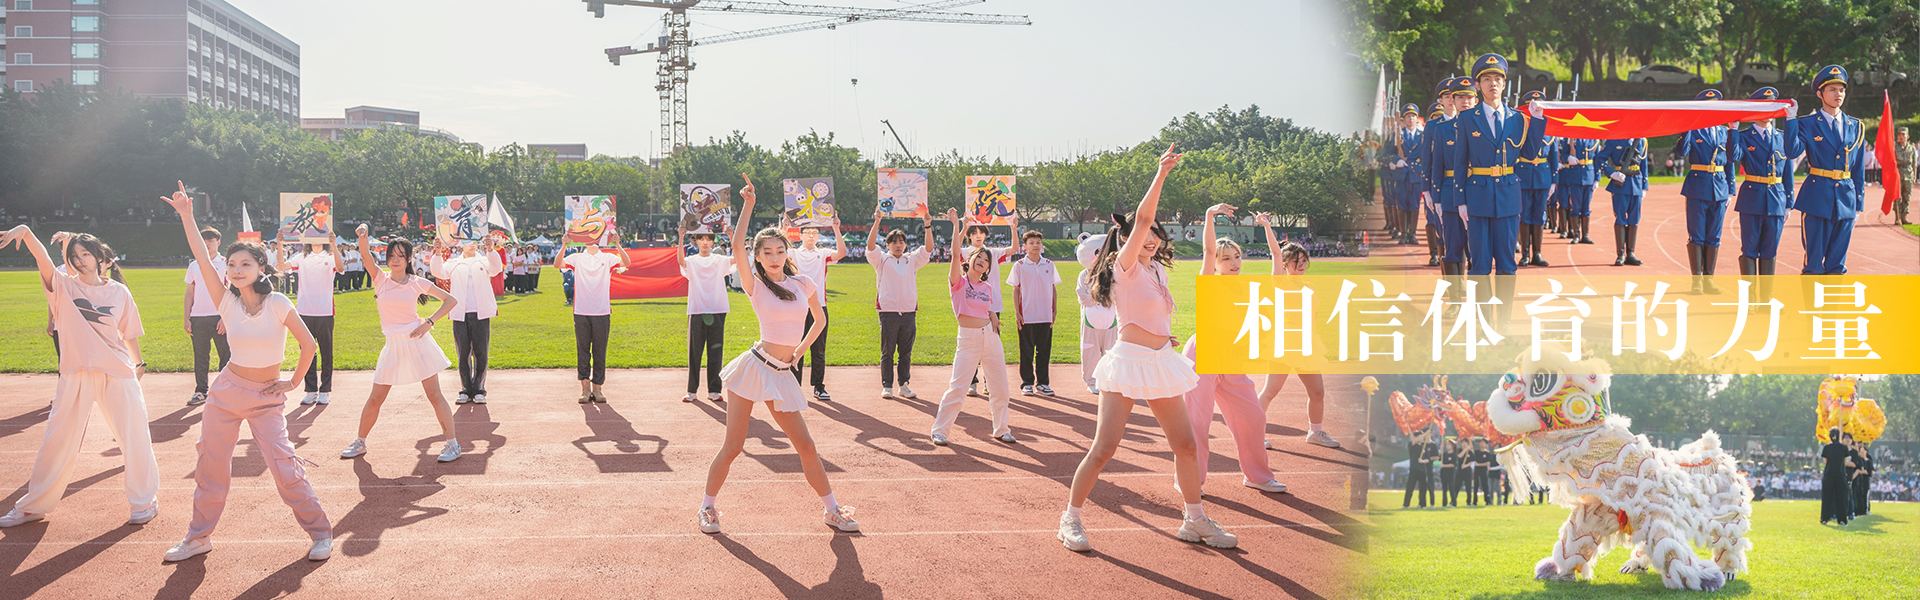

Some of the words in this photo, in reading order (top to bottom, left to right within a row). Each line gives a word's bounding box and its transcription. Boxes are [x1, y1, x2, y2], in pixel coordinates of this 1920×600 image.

[796, 187, 832, 220] 术
[890, 178, 916, 207] 学
[975, 185, 1015, 217] 院
[290, 203, 326, 234] 教
[449, 203, 483, 241] 育
[571, 201, 606, 241] 与
